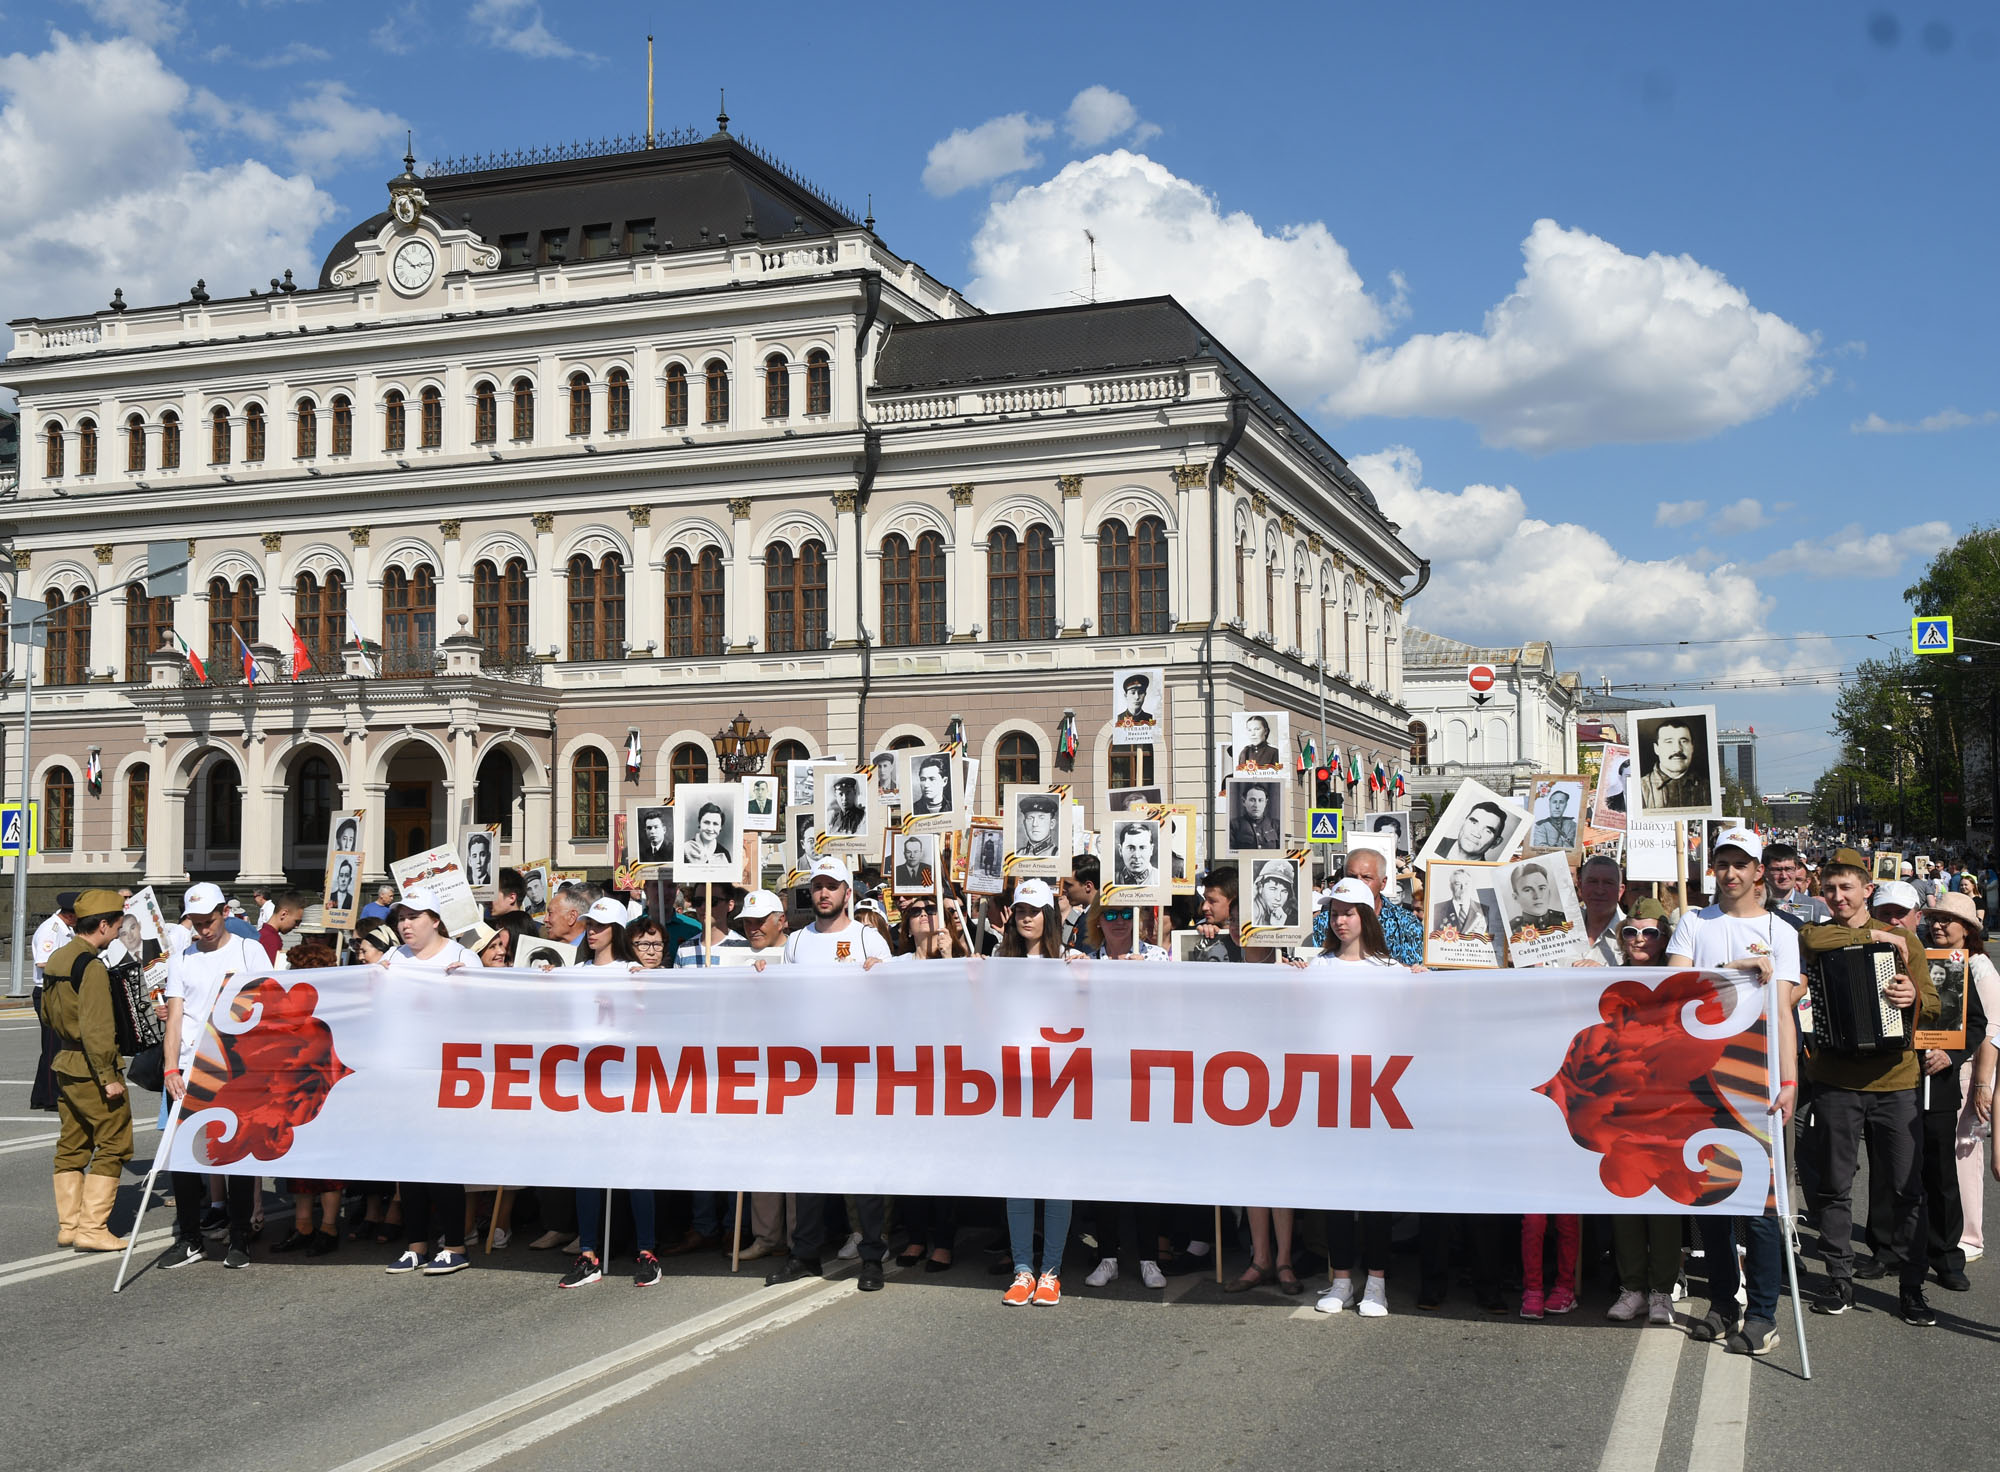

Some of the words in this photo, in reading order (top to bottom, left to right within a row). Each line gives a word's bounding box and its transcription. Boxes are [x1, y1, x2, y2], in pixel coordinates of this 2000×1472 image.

[1518, 947, 1539, 956] Сабир
[1541, 938, 1581, 950] Шакирович
[1529, 933, 1567, 946] ШАКИРОВ
[438, 1026, 1093, 1120] БЕССМЕРТНЫЙ
[1130, 1049, 1415, 1130] ПОЛК
